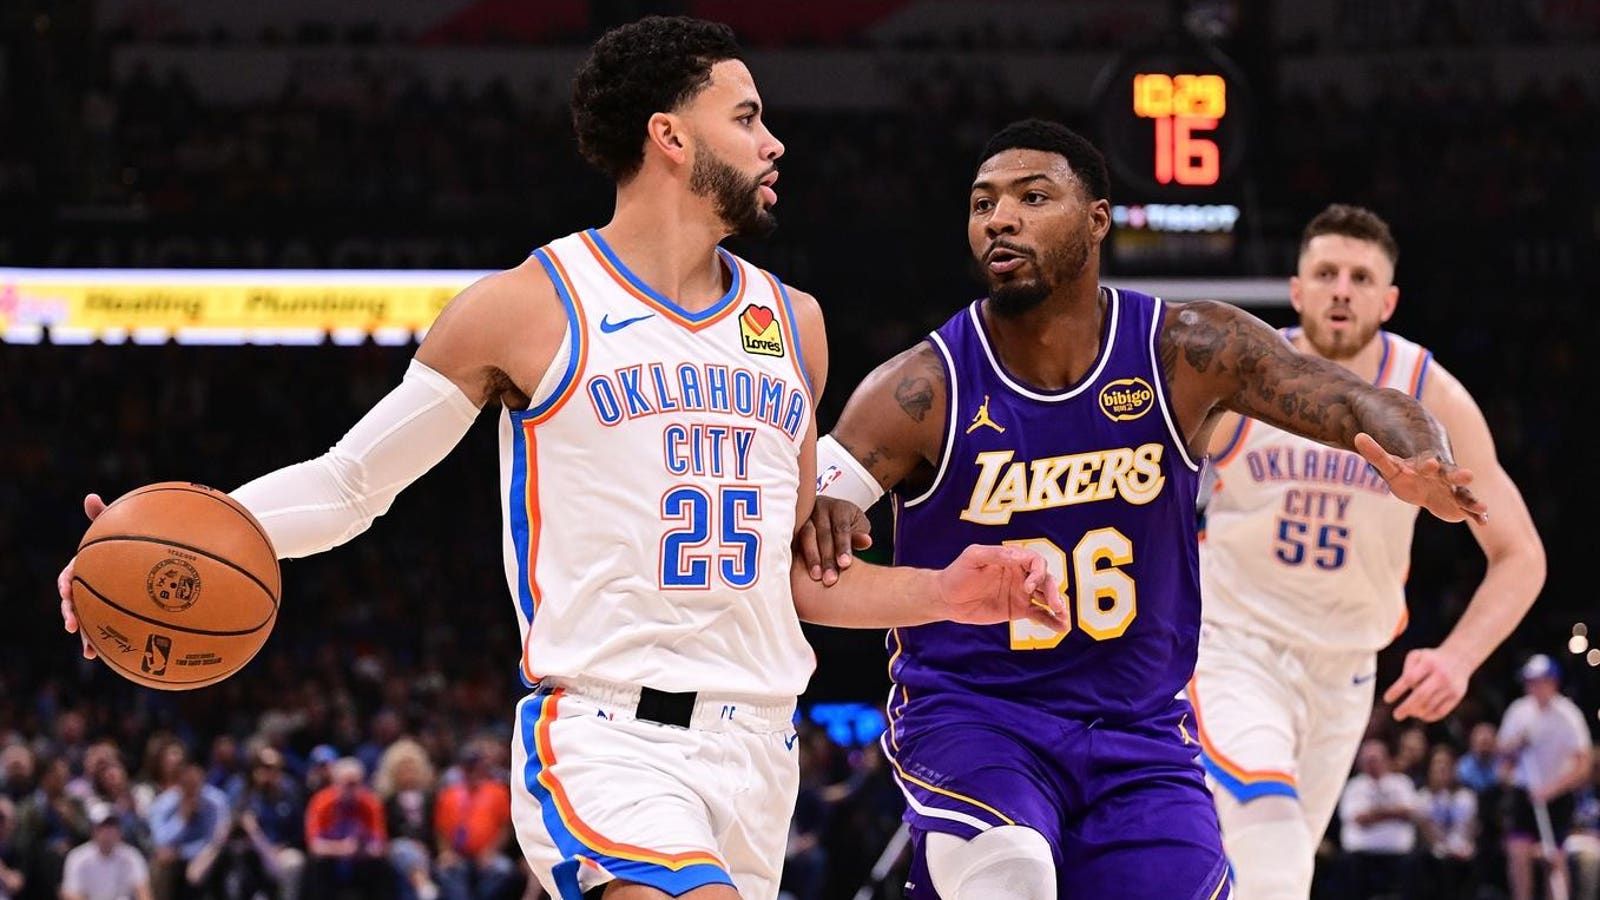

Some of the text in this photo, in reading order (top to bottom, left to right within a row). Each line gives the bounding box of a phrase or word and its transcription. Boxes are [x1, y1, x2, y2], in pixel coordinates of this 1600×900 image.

[1155, 116, 1220, 186] 16
[587, 362, 806, 441] OKLAHOMA
[1103, 389, 1150, 407] bibigo
[663, 423, 756, 480] CITY
[1247, 446, 1391, 495] OKLAHOM
[959, 443, 1166, 526] LAKERS
[1284, 488, 1353, 520] CITY
[659, 484, 763, 590] 25
[1274, 518, 1350, 572] 55
